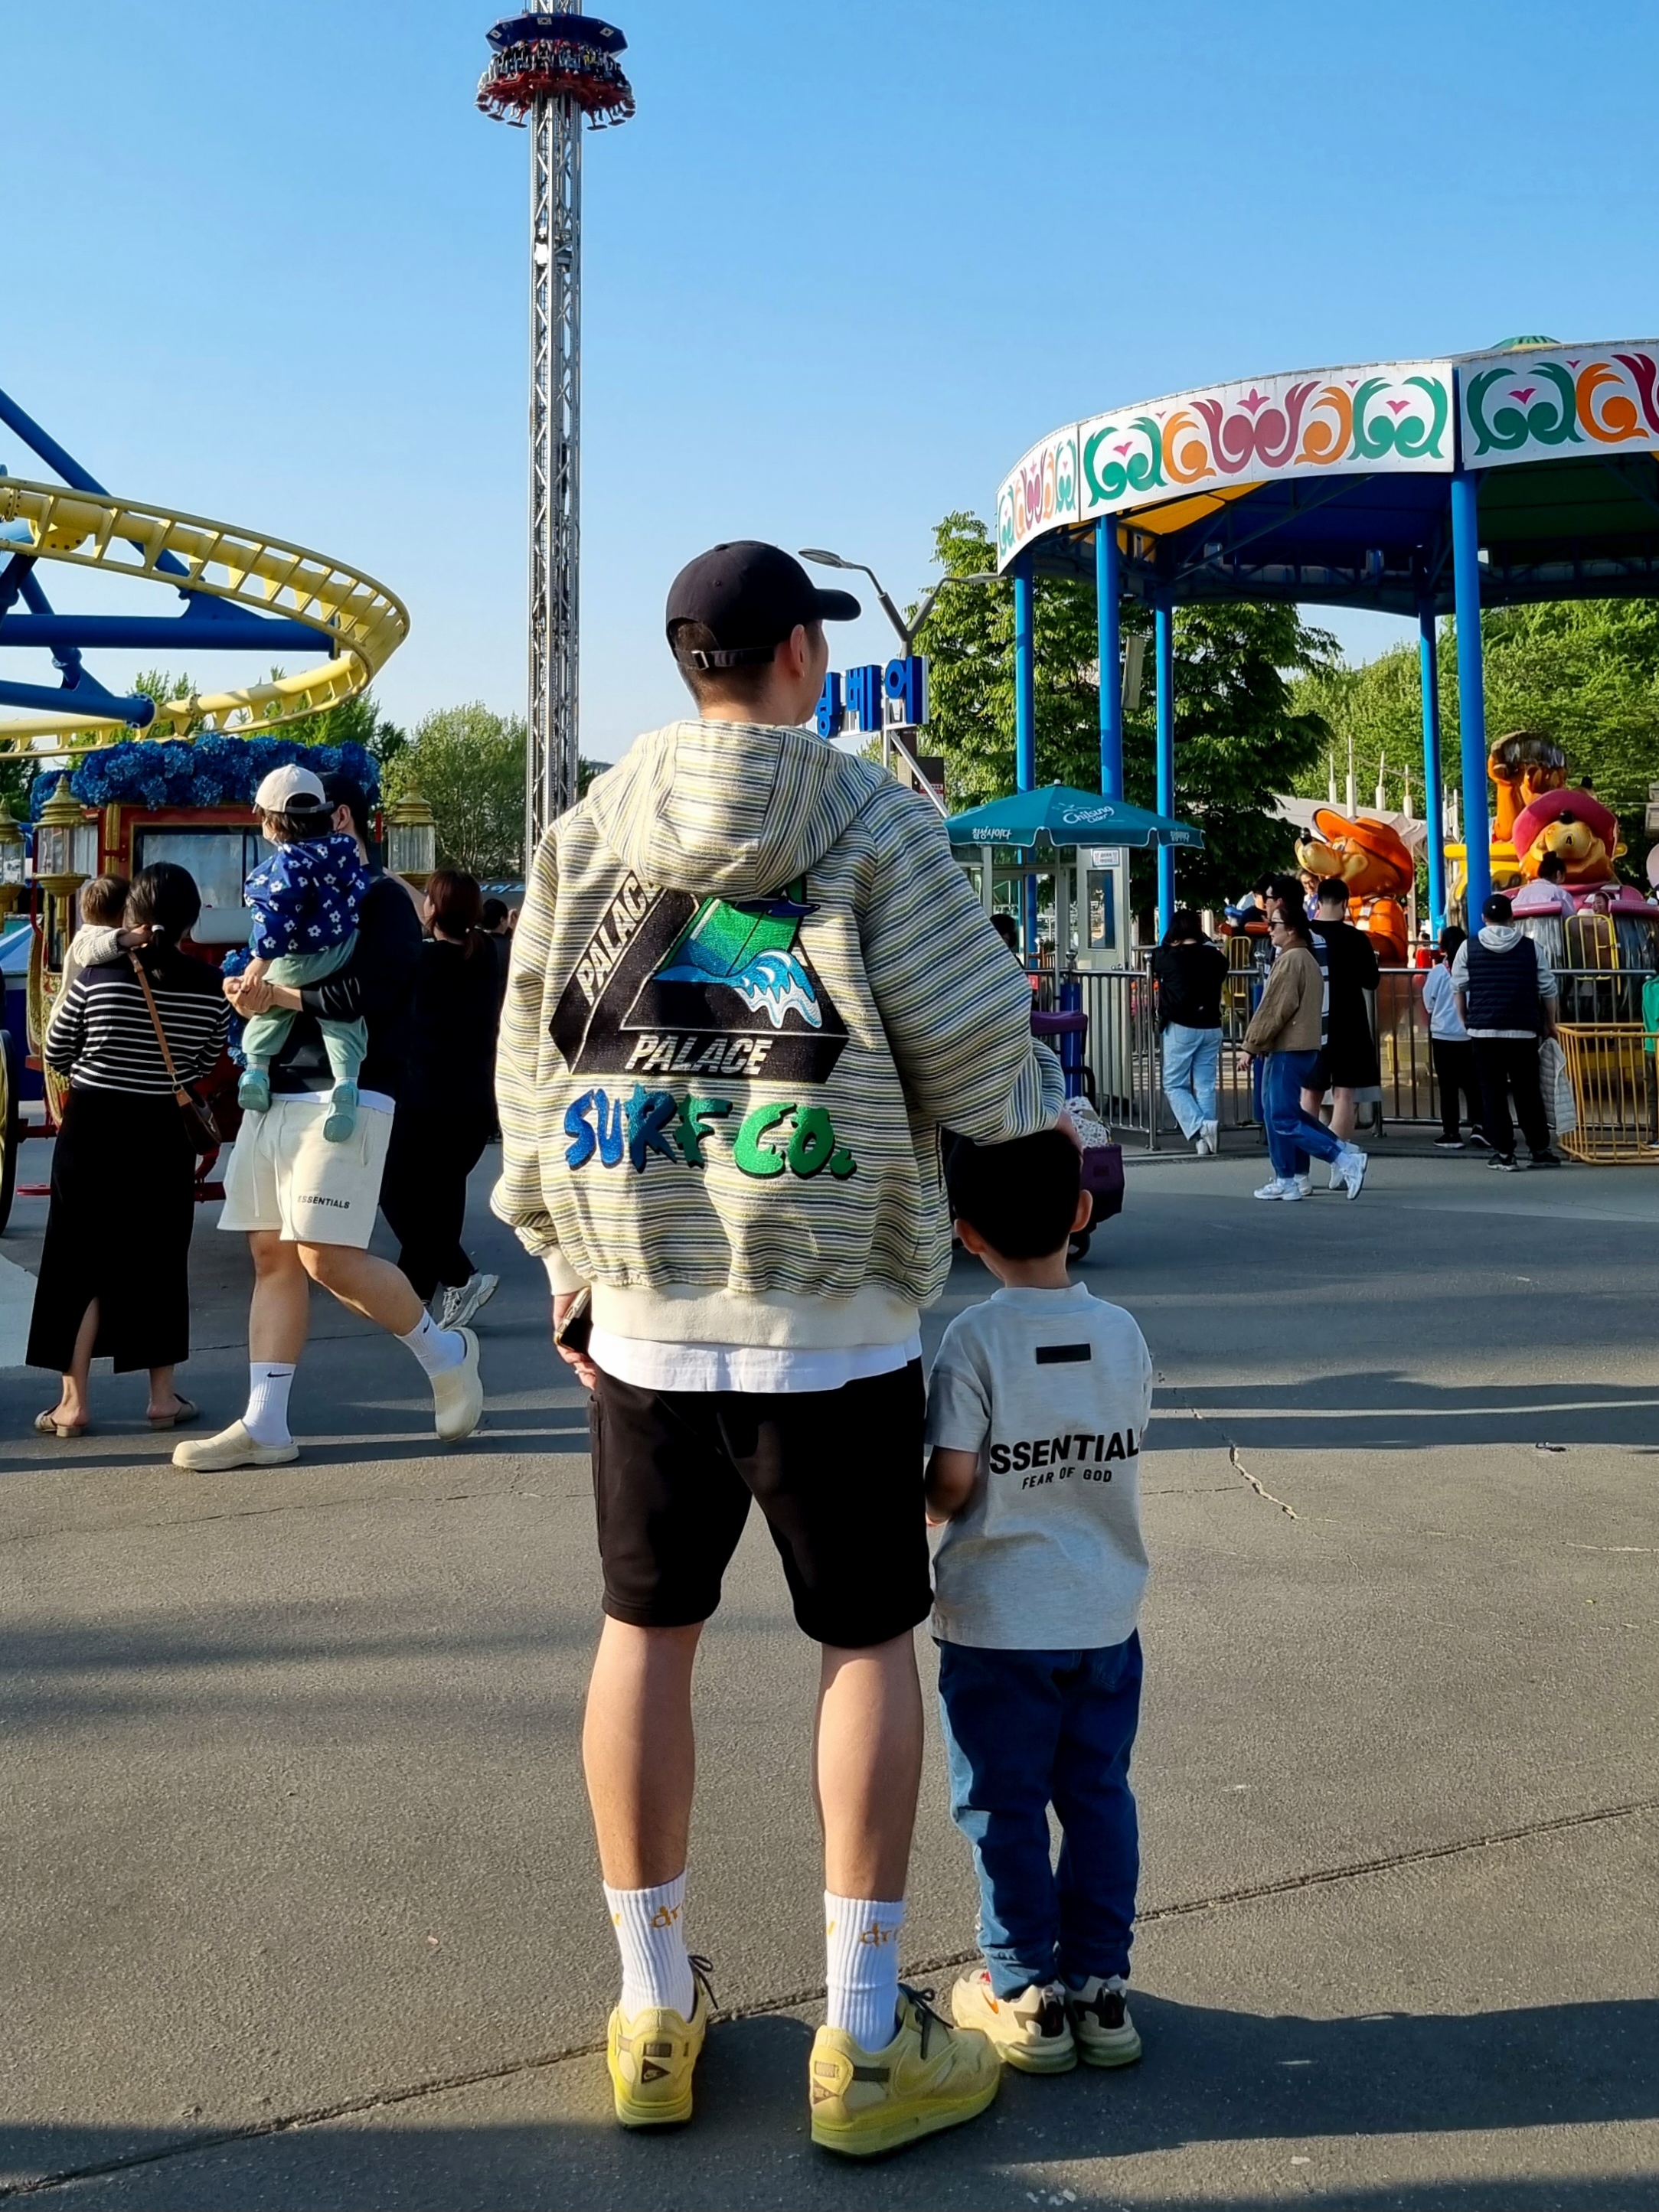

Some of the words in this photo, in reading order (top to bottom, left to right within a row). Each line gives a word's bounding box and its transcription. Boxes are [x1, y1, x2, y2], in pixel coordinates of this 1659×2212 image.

[1063, 805, 1115, 824] Chilsung
[625, 1035, 772, 1075] PALACE
[563, 1083, 733, 1174] SURF
[298, 1196, 351, 1209] ESSENTIALS
[1022, 1471, 1054, 1489] FEAR
[1059, 1467, 1076, 1480] OF
[1083, 1469, 1112, 1483] GOD
[652, 1902, 682, 1928] dr
[861, 1923, 897, 1947] dr
